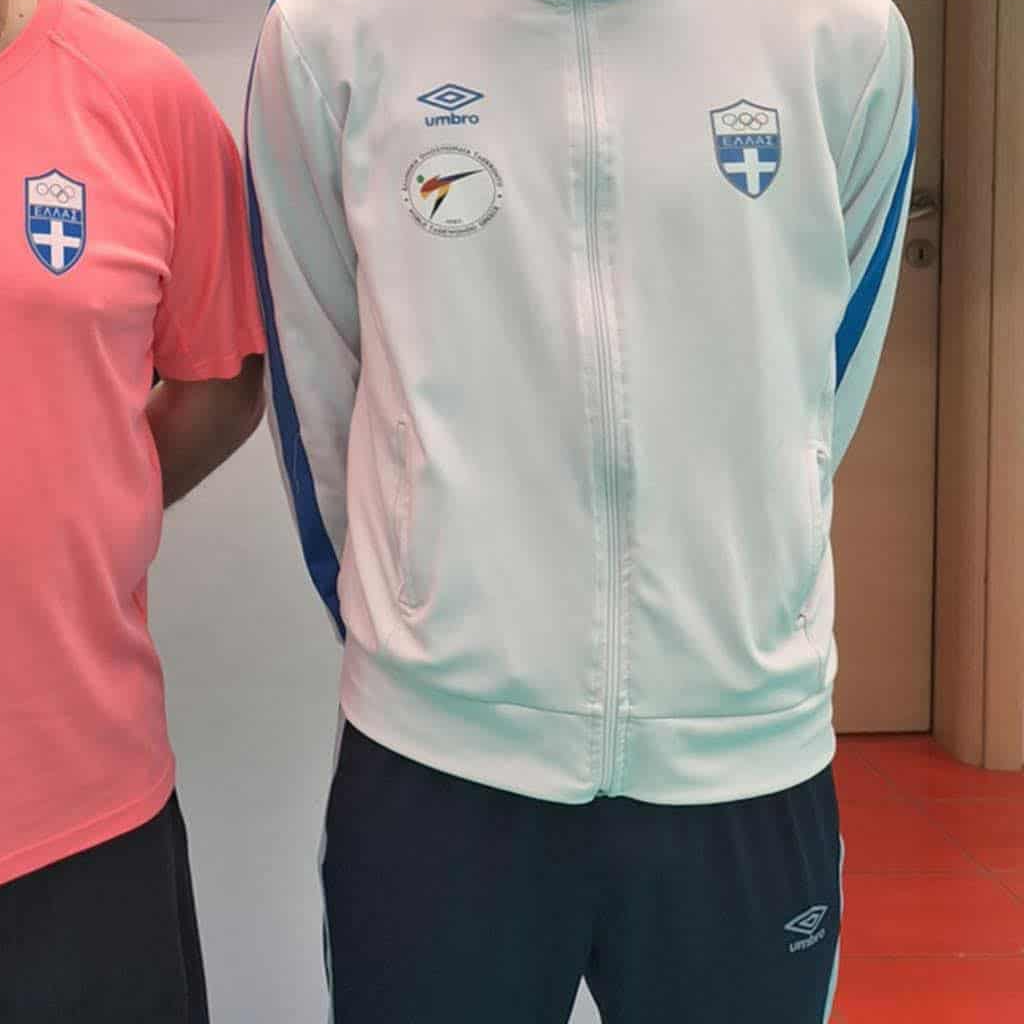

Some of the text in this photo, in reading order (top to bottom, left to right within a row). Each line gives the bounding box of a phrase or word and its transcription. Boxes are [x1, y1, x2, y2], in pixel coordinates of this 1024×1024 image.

[424, 112, 480, 127] umbro
[34, 207, 78, 221] ΕΛΛΑΣ
[789, 928, 826, 953] umbro
